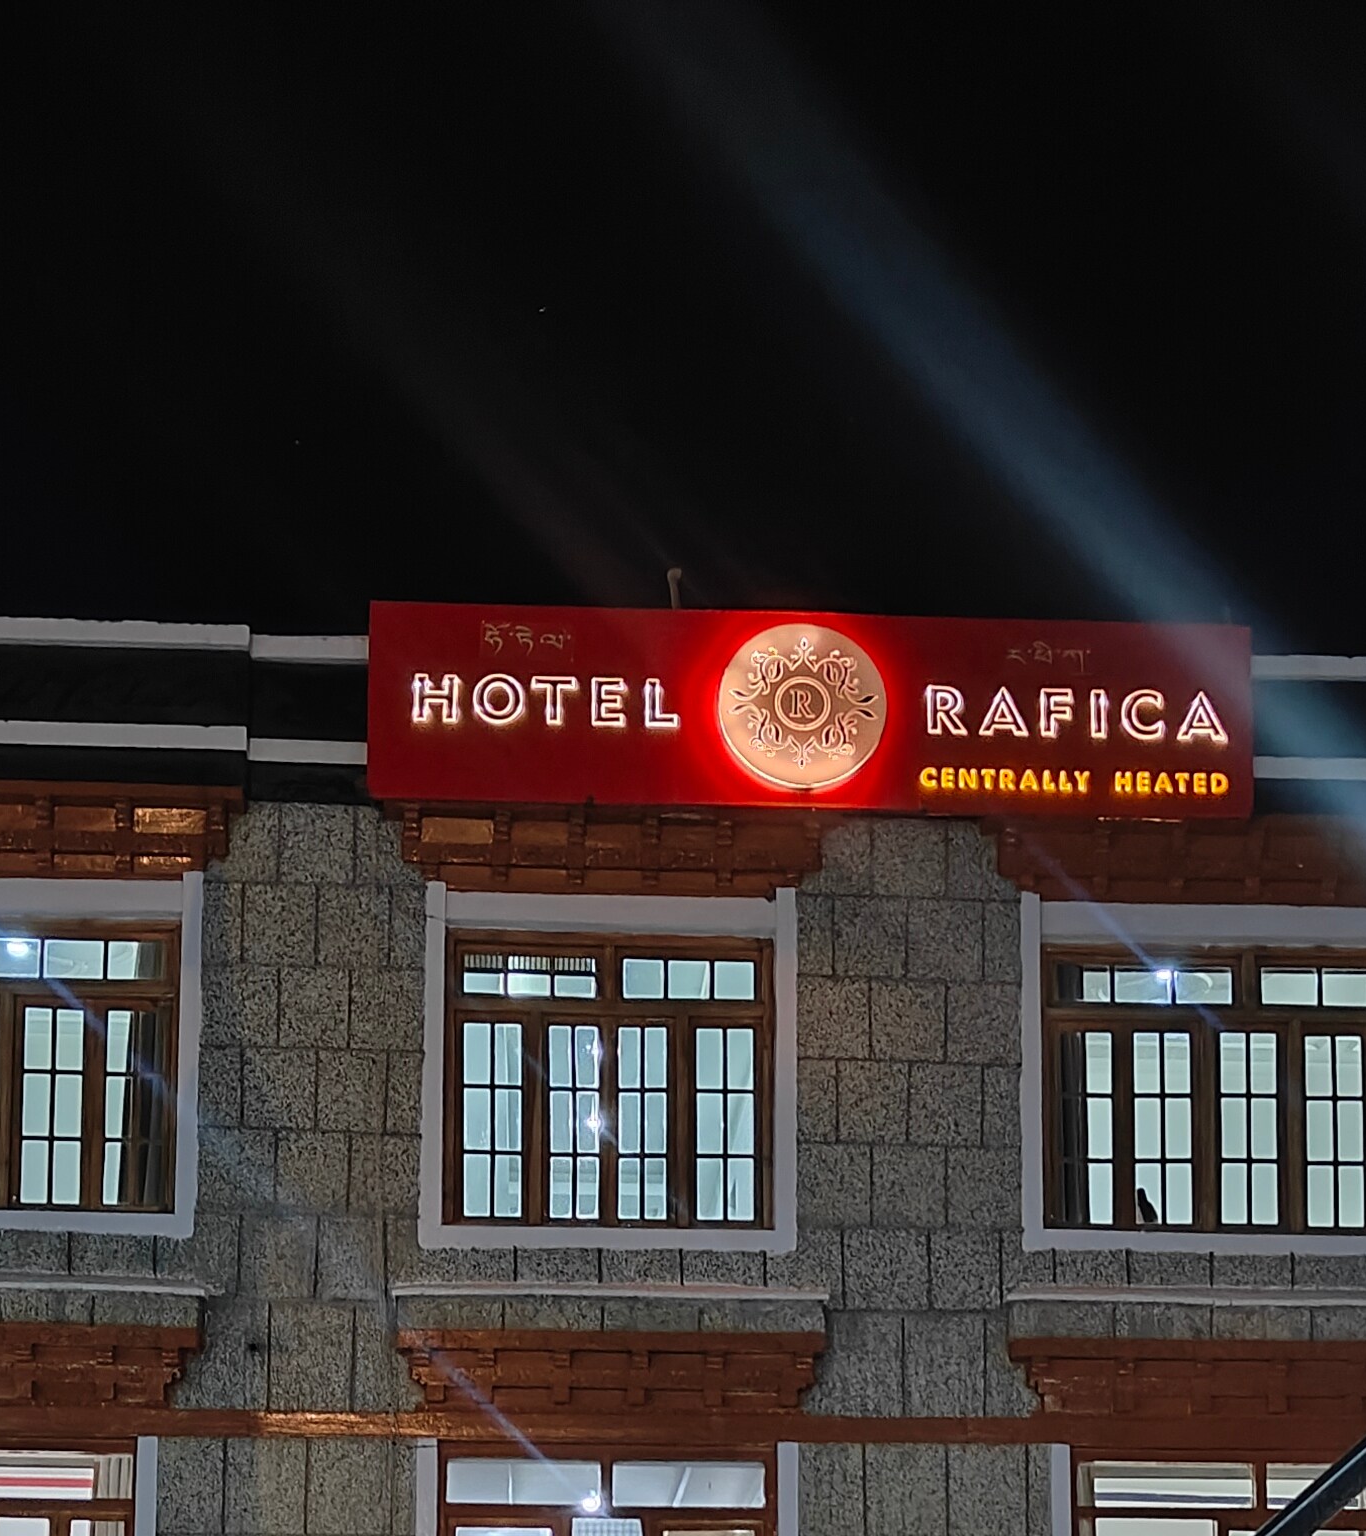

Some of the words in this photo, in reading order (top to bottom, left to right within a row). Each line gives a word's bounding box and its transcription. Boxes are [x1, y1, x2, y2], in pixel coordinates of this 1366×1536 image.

[412, 672, 680, 729] HOTEL
[925, 684, 1229, 745] RAFICA
[789, 689, 816, 719] R
[919, 766, 1091, 794] CENTRALLY
[1114, 770, 1230, 796] HEATED
